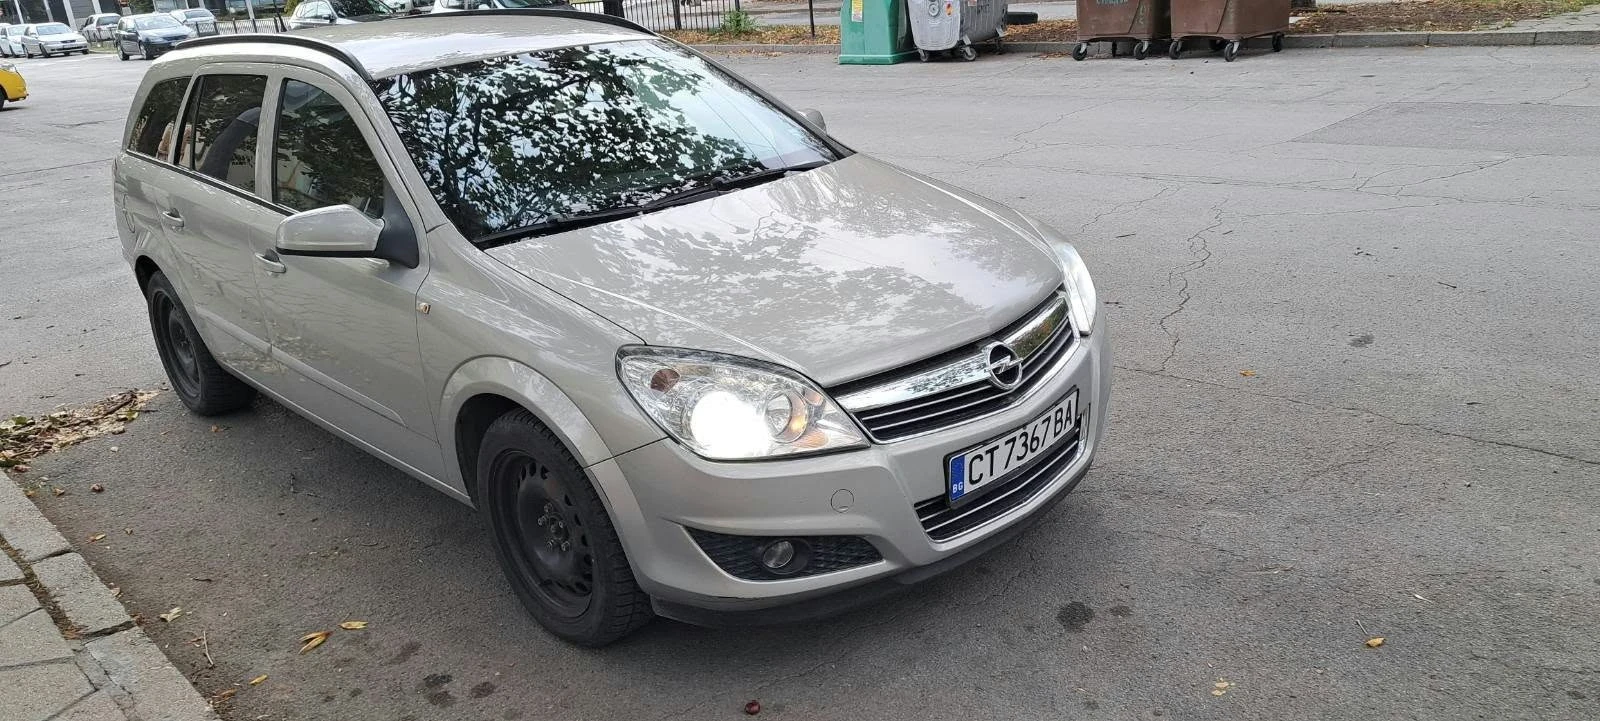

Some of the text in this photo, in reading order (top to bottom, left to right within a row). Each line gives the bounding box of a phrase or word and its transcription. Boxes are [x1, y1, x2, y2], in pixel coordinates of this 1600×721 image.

[968, 400, 1072, 485] CT 7367 BA
[952, 481, 963, 494] BG
